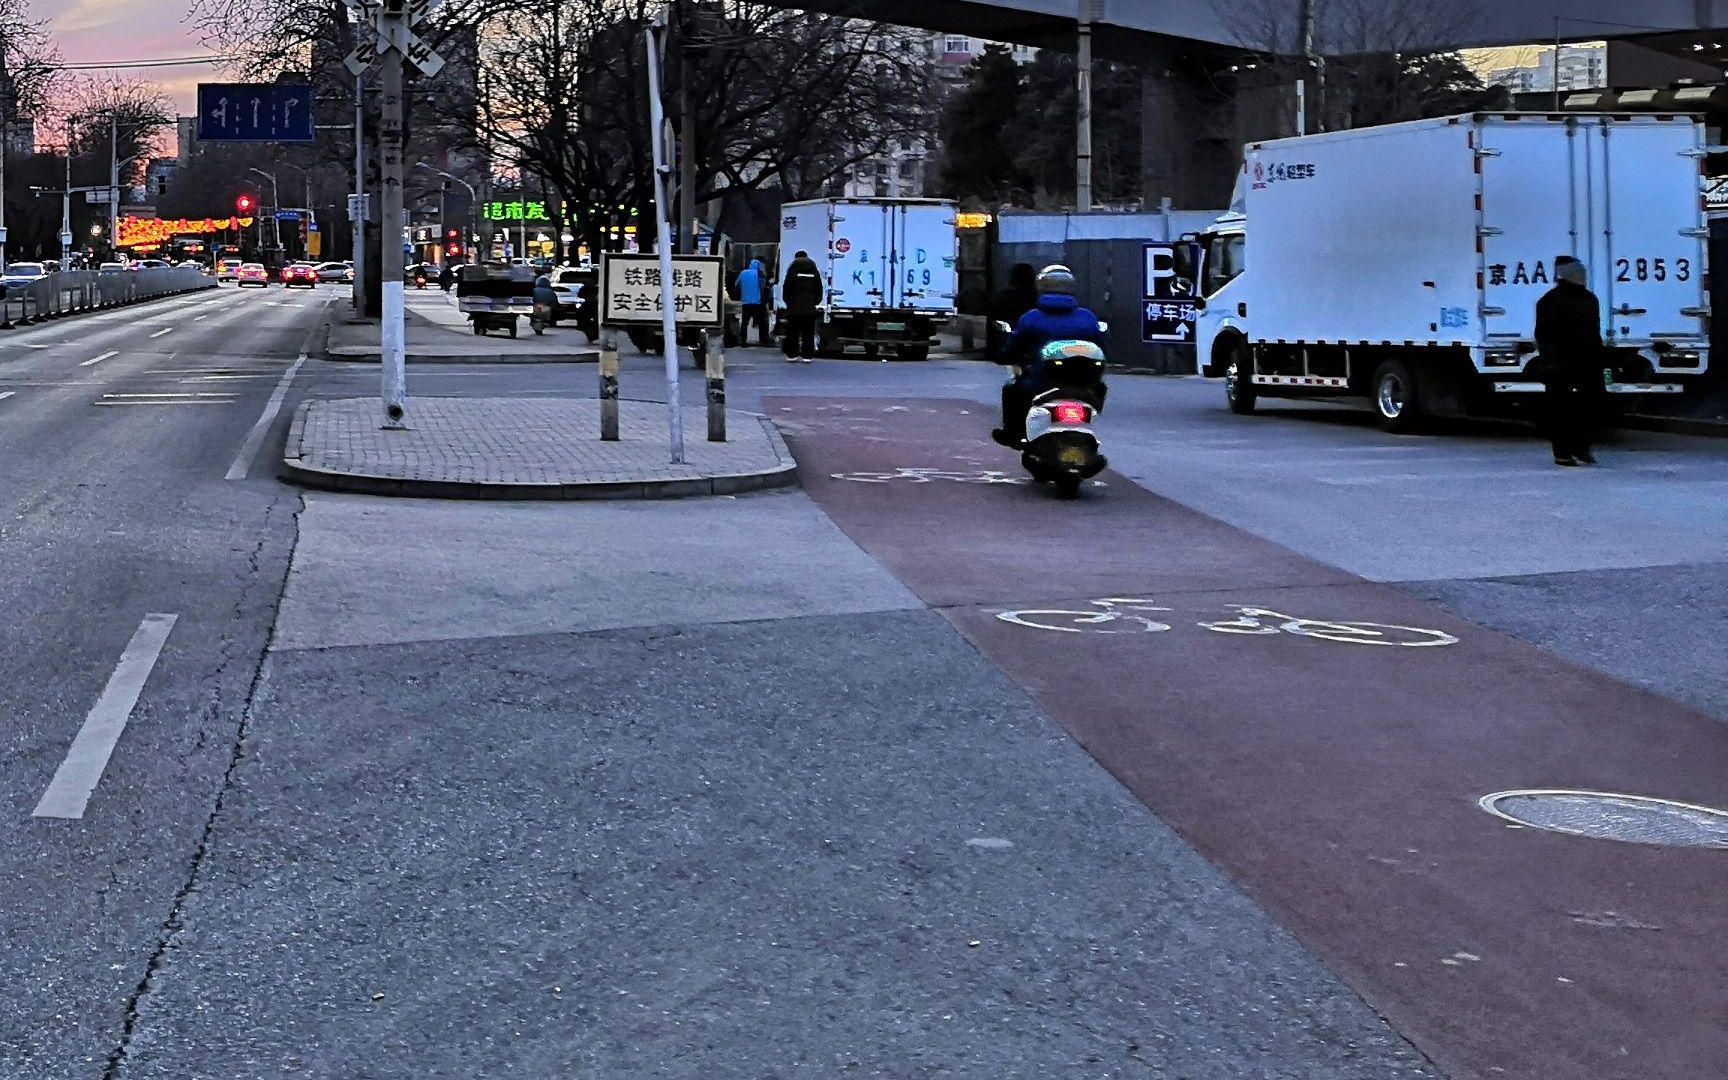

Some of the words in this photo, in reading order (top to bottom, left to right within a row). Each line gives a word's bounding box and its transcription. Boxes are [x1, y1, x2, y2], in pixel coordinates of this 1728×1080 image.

[1146, 247, 1176, 296] P
[1616, 258, 1690, 281] 2853
[1145, 302, 1196, 322] 停车场
